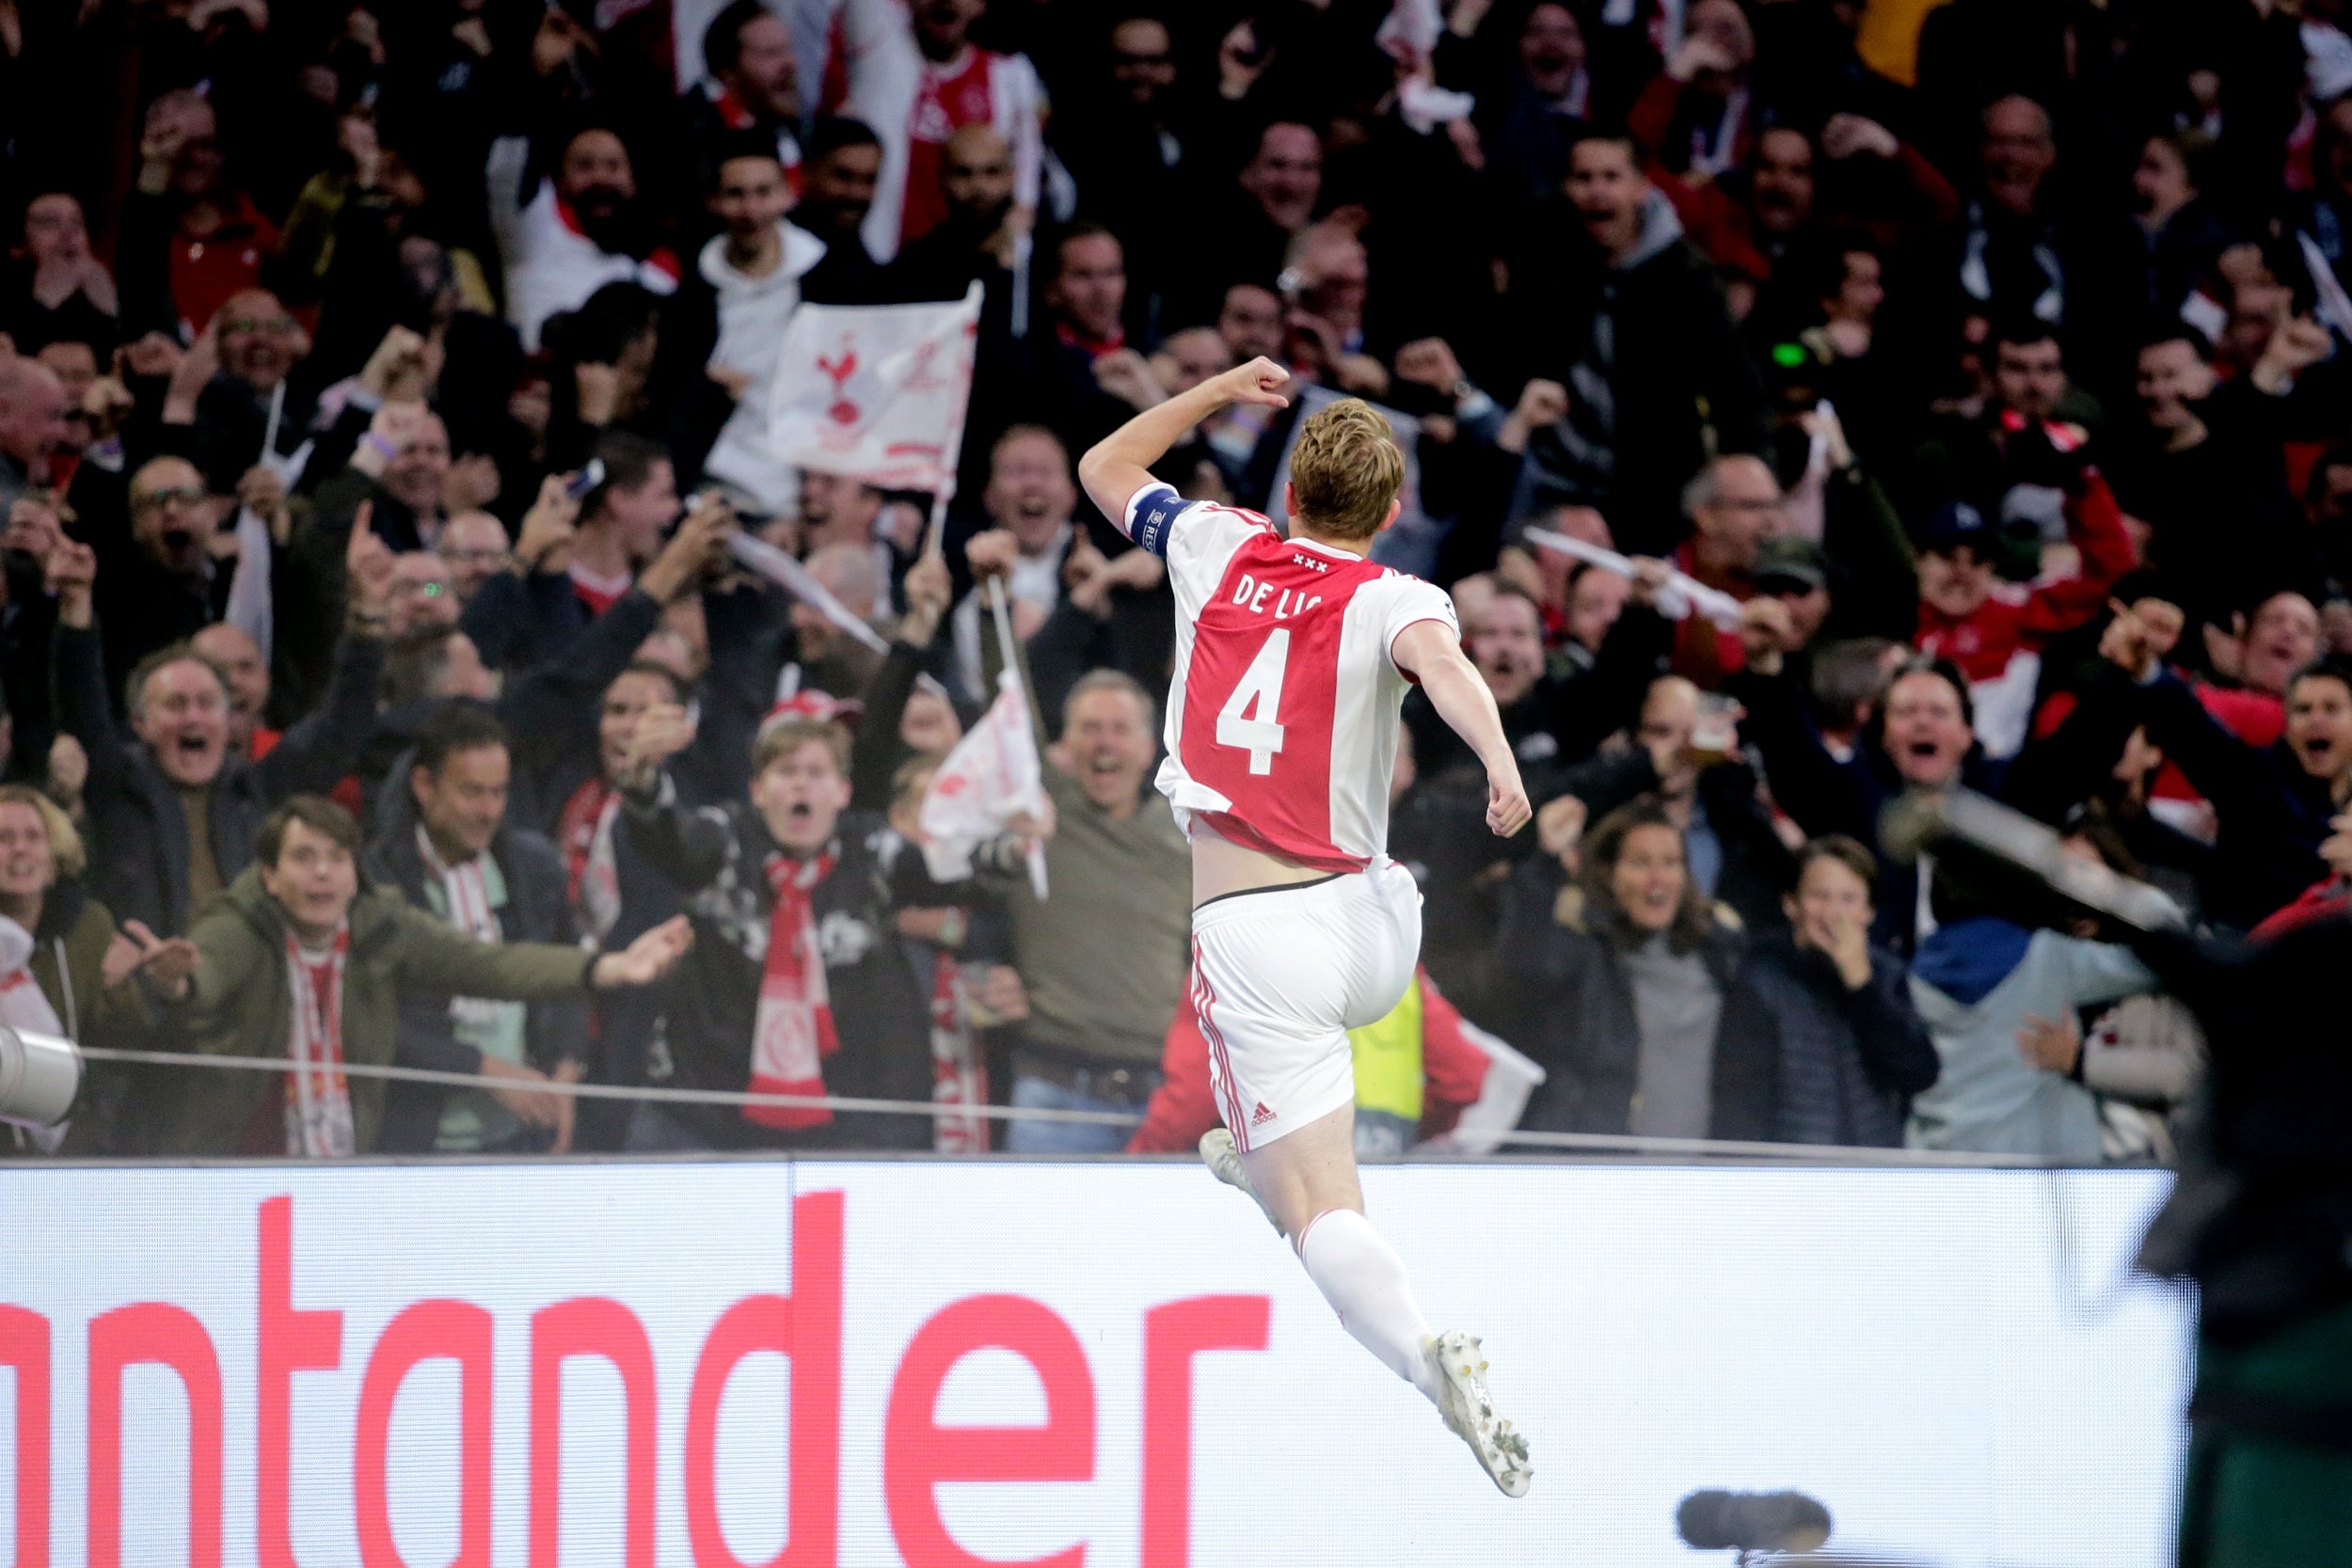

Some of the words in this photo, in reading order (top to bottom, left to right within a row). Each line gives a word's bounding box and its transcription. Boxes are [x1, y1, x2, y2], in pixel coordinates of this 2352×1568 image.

[1232, 573, 1274, 613] DE
[1216, 627, 1290, 776] 4
[1251, 1112, 1278, 1126] adidas
